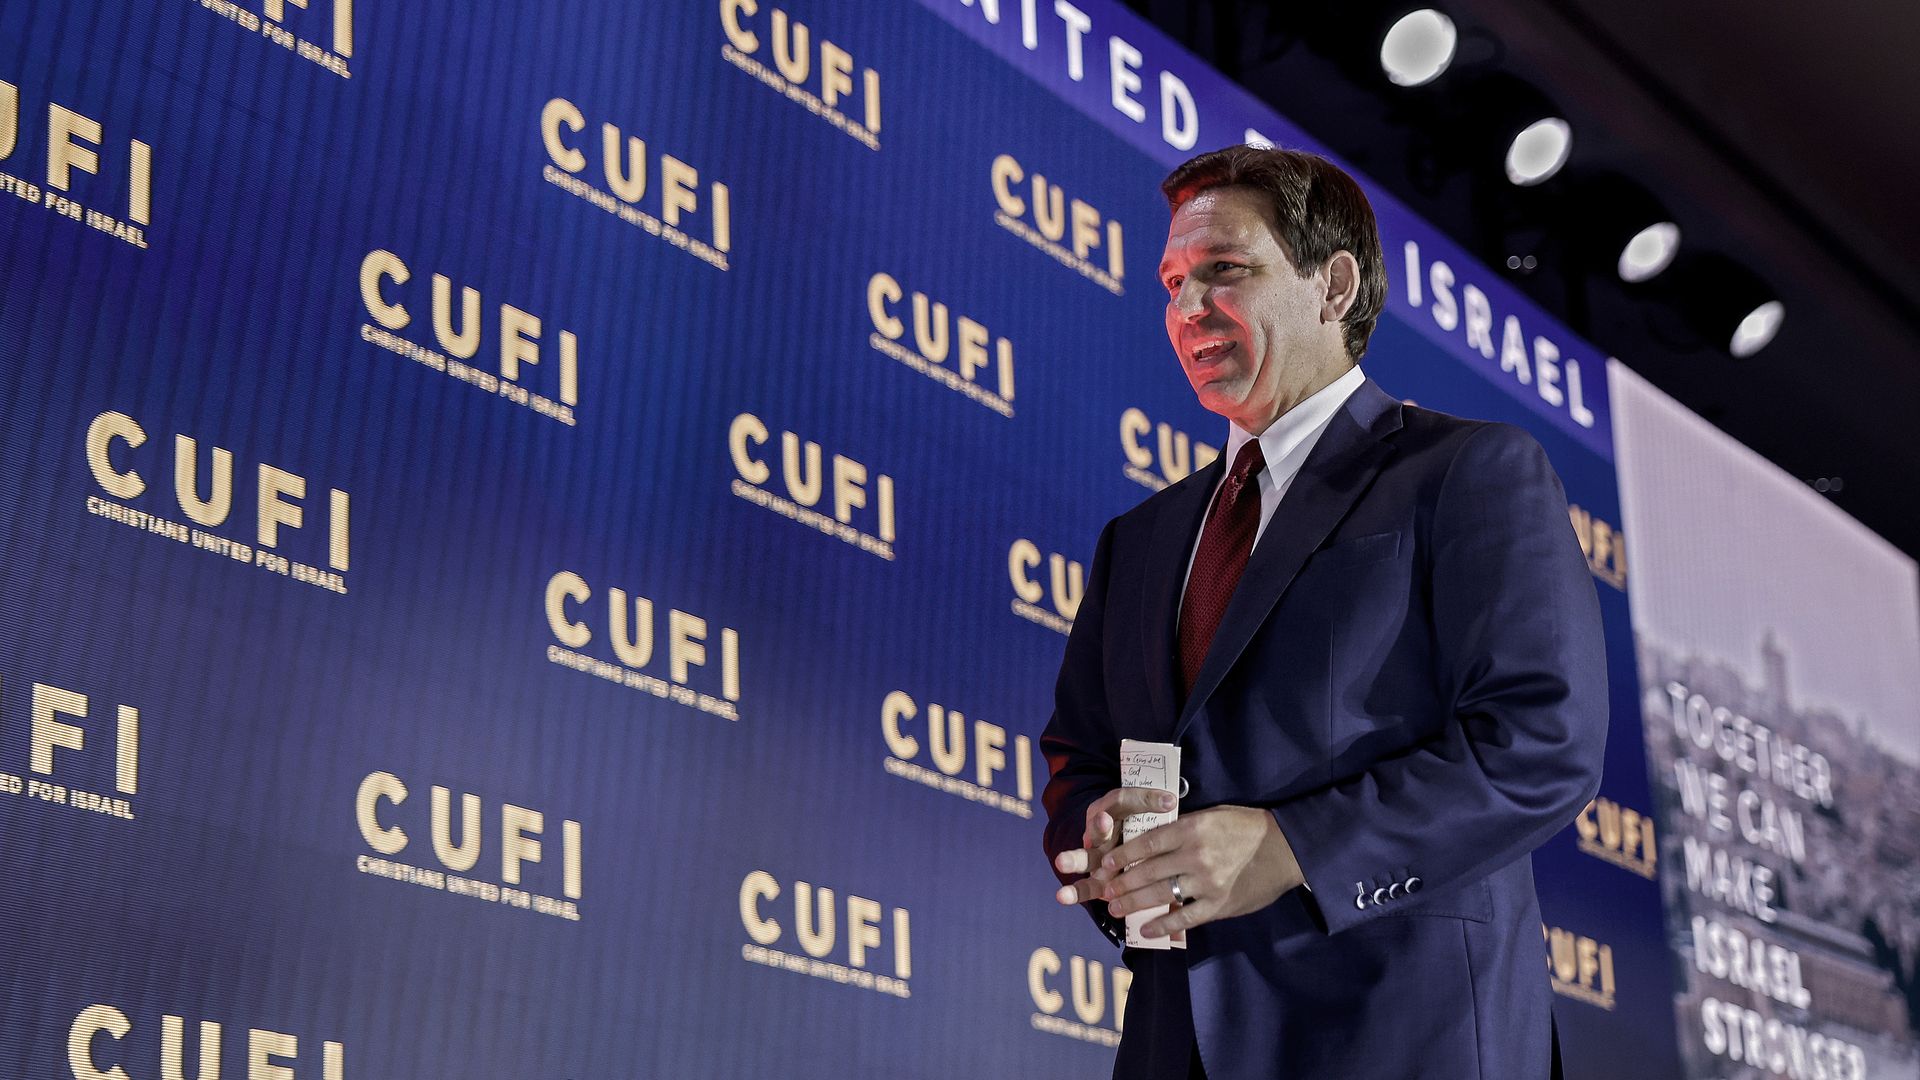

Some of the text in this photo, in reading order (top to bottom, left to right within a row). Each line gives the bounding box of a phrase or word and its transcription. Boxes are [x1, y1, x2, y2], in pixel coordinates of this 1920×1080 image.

[262, 20, 295, 50] FOR
[297, 38, 352, 79] ISRAEL
[719, 0, 881, 134] CUFI
[960, 0, 1199, 151] ITED
[0, 79, 151, 225] FI
[541, 98, 731, 253] CUFI
[0, 172, 149, 249] ITED FOR ISRAEL
[991, 154, 1125, 280] CUFI
[360, 249, 578, 406] CUFI
[360, 323, 447, 372] CHRISTIANS
[447, 358, 499, 393] UNITED
[500, 380, 529, 406] FOR
[867, 272, 1015, 402] CUFI
[1405, 240, 1594, 428] ISRAEL
[86, 410, 350, 572] CUFI
[729, 412, 896, 543] CUFI
[86, 496, 348, 595] CHRISTIANS UNITED FOR ISRAEL
[1568, 503, 1627, 576] UFI
[545, 570, 740, 701] CUFI
[28, 682, 140, 796] FI
[881, 690, 1033, 800] CUFI
[1666, 680, 1834, 809] TOGETHER
[28, 780, 67, 805] FOR
[70, 789, 136, 820] ISRAEL
[355, 771, 582, 899] CUFI
[1673, 757, 1733, 833] WE
[1737, 788, 1807, 864] CAN
[357, 854, 446, 890] CHRISTIANS
[446, 874, 499, 902] UNITED
[501, 887, 531, 909] FOR
[740, 870, 911, 979] CUFI
[1683, 834, 1779, 924] MAKE
[1028, 946, 1133, 1033] CUF
[1691, 914, 1812, 1010] ISRAEL
